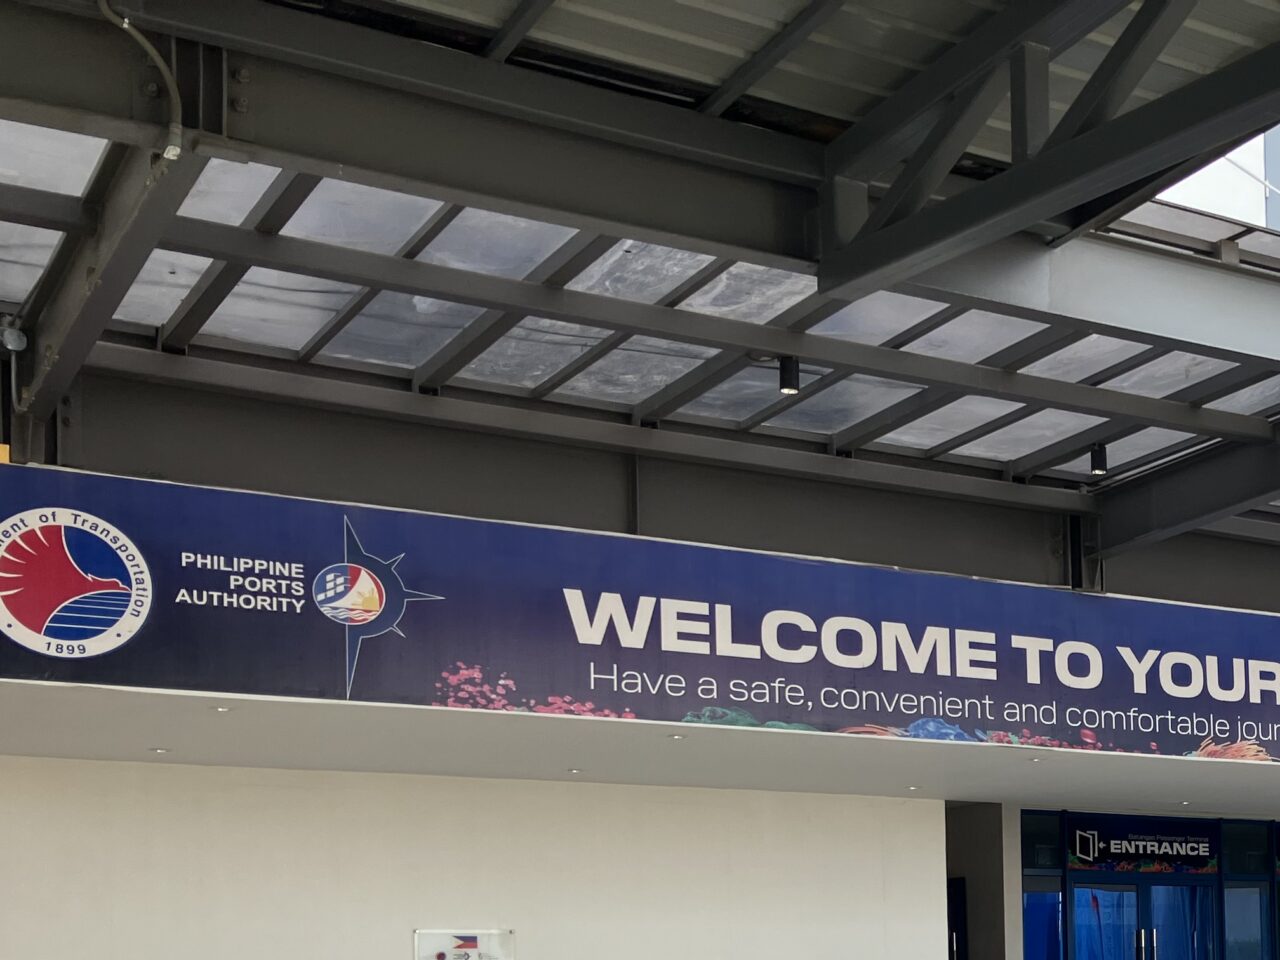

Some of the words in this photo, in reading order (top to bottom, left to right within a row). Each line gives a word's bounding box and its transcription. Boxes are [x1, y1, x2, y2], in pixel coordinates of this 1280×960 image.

[39, 511, 57, 523] of
[71, 513, 149, 618] Transportation
[181, 551, 305, 578] PHILIPPINE
[229, 574, 305, 596] PORTS
[175, 588, 306, 614] AUTHORITY
[45, 641, 87, 655] 1899
[562, 587, 998, 681] WELCOME
[1011, 635, 1103, 690] TO
[589, 662, 687, 697] Have
[697, 677, 719, 700] a
[729, 677, 814, 712] safe,
[821, 686, 995, 722] convenient
[1003, 700, 1057, 726] and
[1065, 706, 1231, 739] comfortable
[1110, 840, 1210, 856] ENTRANCE
